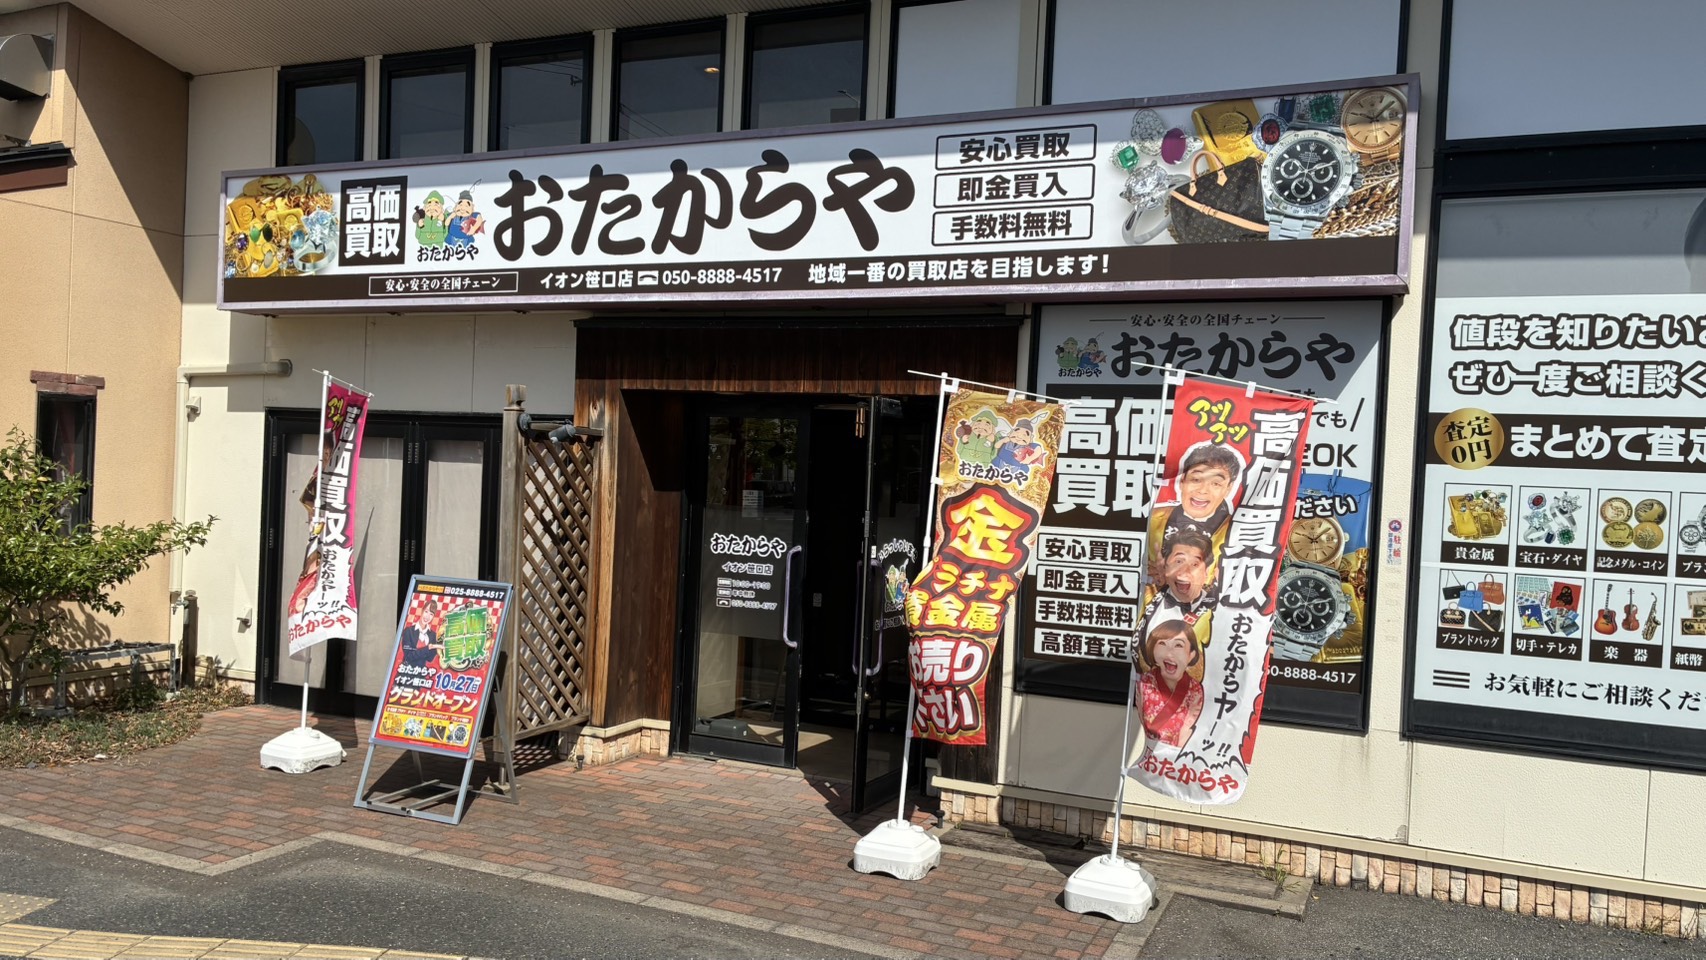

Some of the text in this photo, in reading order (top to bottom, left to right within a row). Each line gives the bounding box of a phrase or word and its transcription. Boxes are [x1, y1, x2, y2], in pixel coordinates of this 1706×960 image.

[960, 132, 1070, 163] 安心買取
[957, 171, 1068, 203] 即金買入
[345, 184, 401, 222] 高価
[494, 148, 914, 262] おたからや
[950, 209, 1072, 241] 手数料無料
[344, 222, 400, 260] 買取
[417, 244, 479, 263] おたからや
[385, 276, 501, 292] 安心・安全の全国チェーン
[539, 270, 634, 290] イオン笹口店
[662, 266, 783, 287] 050-8888-4517
[1130, 312, 1281, 327] 安心・安全の全国チェーン
[1110, 330, 1355, 381] おたからや
[1058, 367, 1103, 378] おたからや
[1189, 398, 1232, 428] アツ
[1059, 397, 1173, 457] 高価
[1208, 421, 1249, 444] アツ
[1443, 416, 1493, 443] 査定
[1451, 439, 1493, 464] 0円
[958, 460, 1029, 487] おたからや
[1052, 458, 1164, 519] 買取
[1218, 411, 1306, 606] 高価買取
[949, 493, 1025, 566] 金
[710, 533, 787, 559] おたからや
[1044, 537, 1133, 563] 安心買取
[1454, 546, 1495, 562] 貴金属
[1519, 551, 1583, 566] 宝石・ダイヤ
[721, 562, 774, 576] イオン笹口店
[1596, 556, 1666, 571] 記念メダル・コイン
[450, 587, 505, 600] 025-8888-4517
[1042, 568, 1131, 596] 即金買入
[1038, 600, 1134, 629] 手数料無料
[288, 615, 352, 644] おたからや
[1441, 632, 1500, 648] ブランドバッグ
[1041, 630, 1129, 661] 高額査定
[1515, 637, 1578, 655] 切手・テレカ
[397, 663, 437, 678] おたからや
[1674, 652, 1703, 667] 紙幣
[389, 685, 478, 714] グランドオープン
[1141, 754, 1239, 794] おたからや
